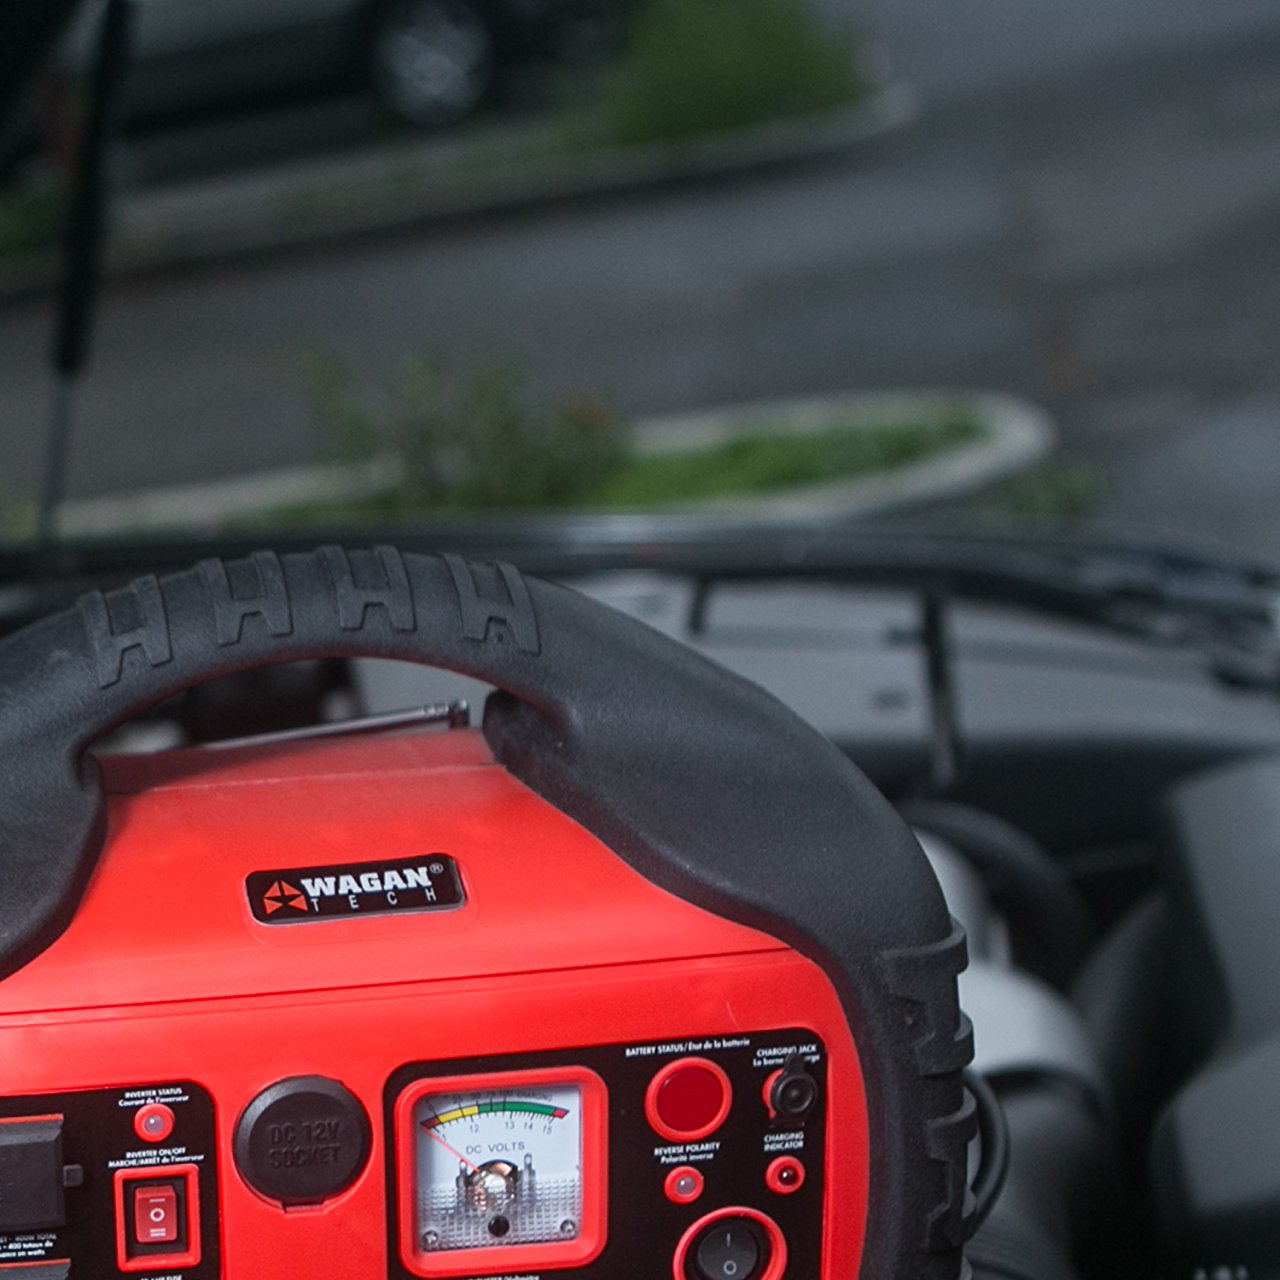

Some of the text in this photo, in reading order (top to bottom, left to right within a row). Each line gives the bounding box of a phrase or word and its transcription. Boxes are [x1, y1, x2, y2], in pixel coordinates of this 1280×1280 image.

[311, 889, 437, 912] TECH
[625, 1046, 656, 1057] BATTERY
[703, 1040, 712, 1050] de
[722, 1037, 750, 1048] batterie
[798, 1044, 817, 1053] JACK
[124, 1087, 182, 1099] INVERTER STATUS
[270, 1118, 340, 1144] DC 12V
[469, 1123, 480, 1134] 12
[505, 1121, 515, 1130] 13
[524, 1121, 534, 1131] 14
[542, 1125, 552, 1135] 15
[763, 1131, 804, 1143] CHARGING
[465, 1140, 525, 1155] DC VOLTS
[654, 1142, 720, 1157] REVERSE POLARITY
[764, 1140, 804, 1152] INDICATOR
[126, 1147, 187, 1159] INVERTER ON/OFF
[269, 1143, 341, 1168] SOCKET
